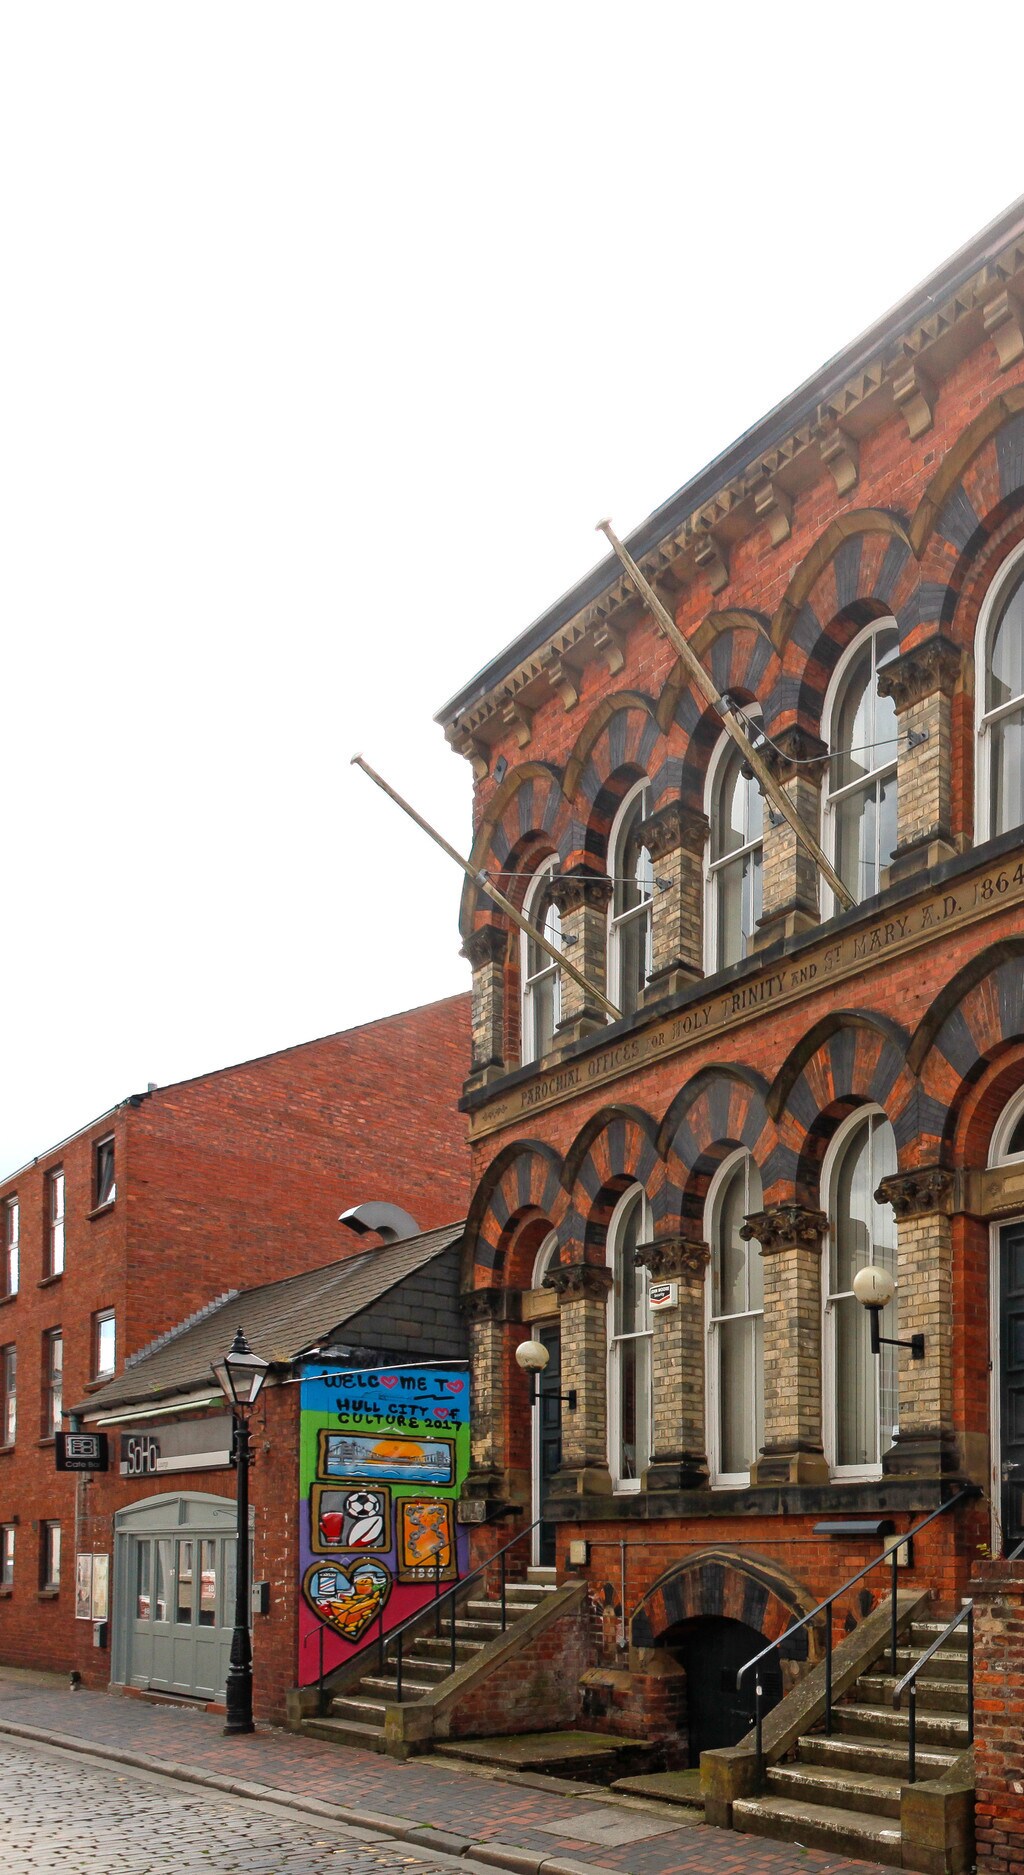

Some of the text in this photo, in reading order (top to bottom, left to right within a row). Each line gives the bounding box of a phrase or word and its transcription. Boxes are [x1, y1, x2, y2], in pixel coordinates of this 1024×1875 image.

[521, 1067, 582, 1108] PAROCHIAL
[588, 1040, 640, 1076] OFFICES
[672, 1006, 712, 1040] HOLY
[722, 972, 786, 1016] TRINITY
[790, 963, 817, 987] AND
[336, 1399, 380, 1412] HULL
[388, 1404, 429, 1416] CITY
[338, 1412, 462, 1431] CULTURE 2017
